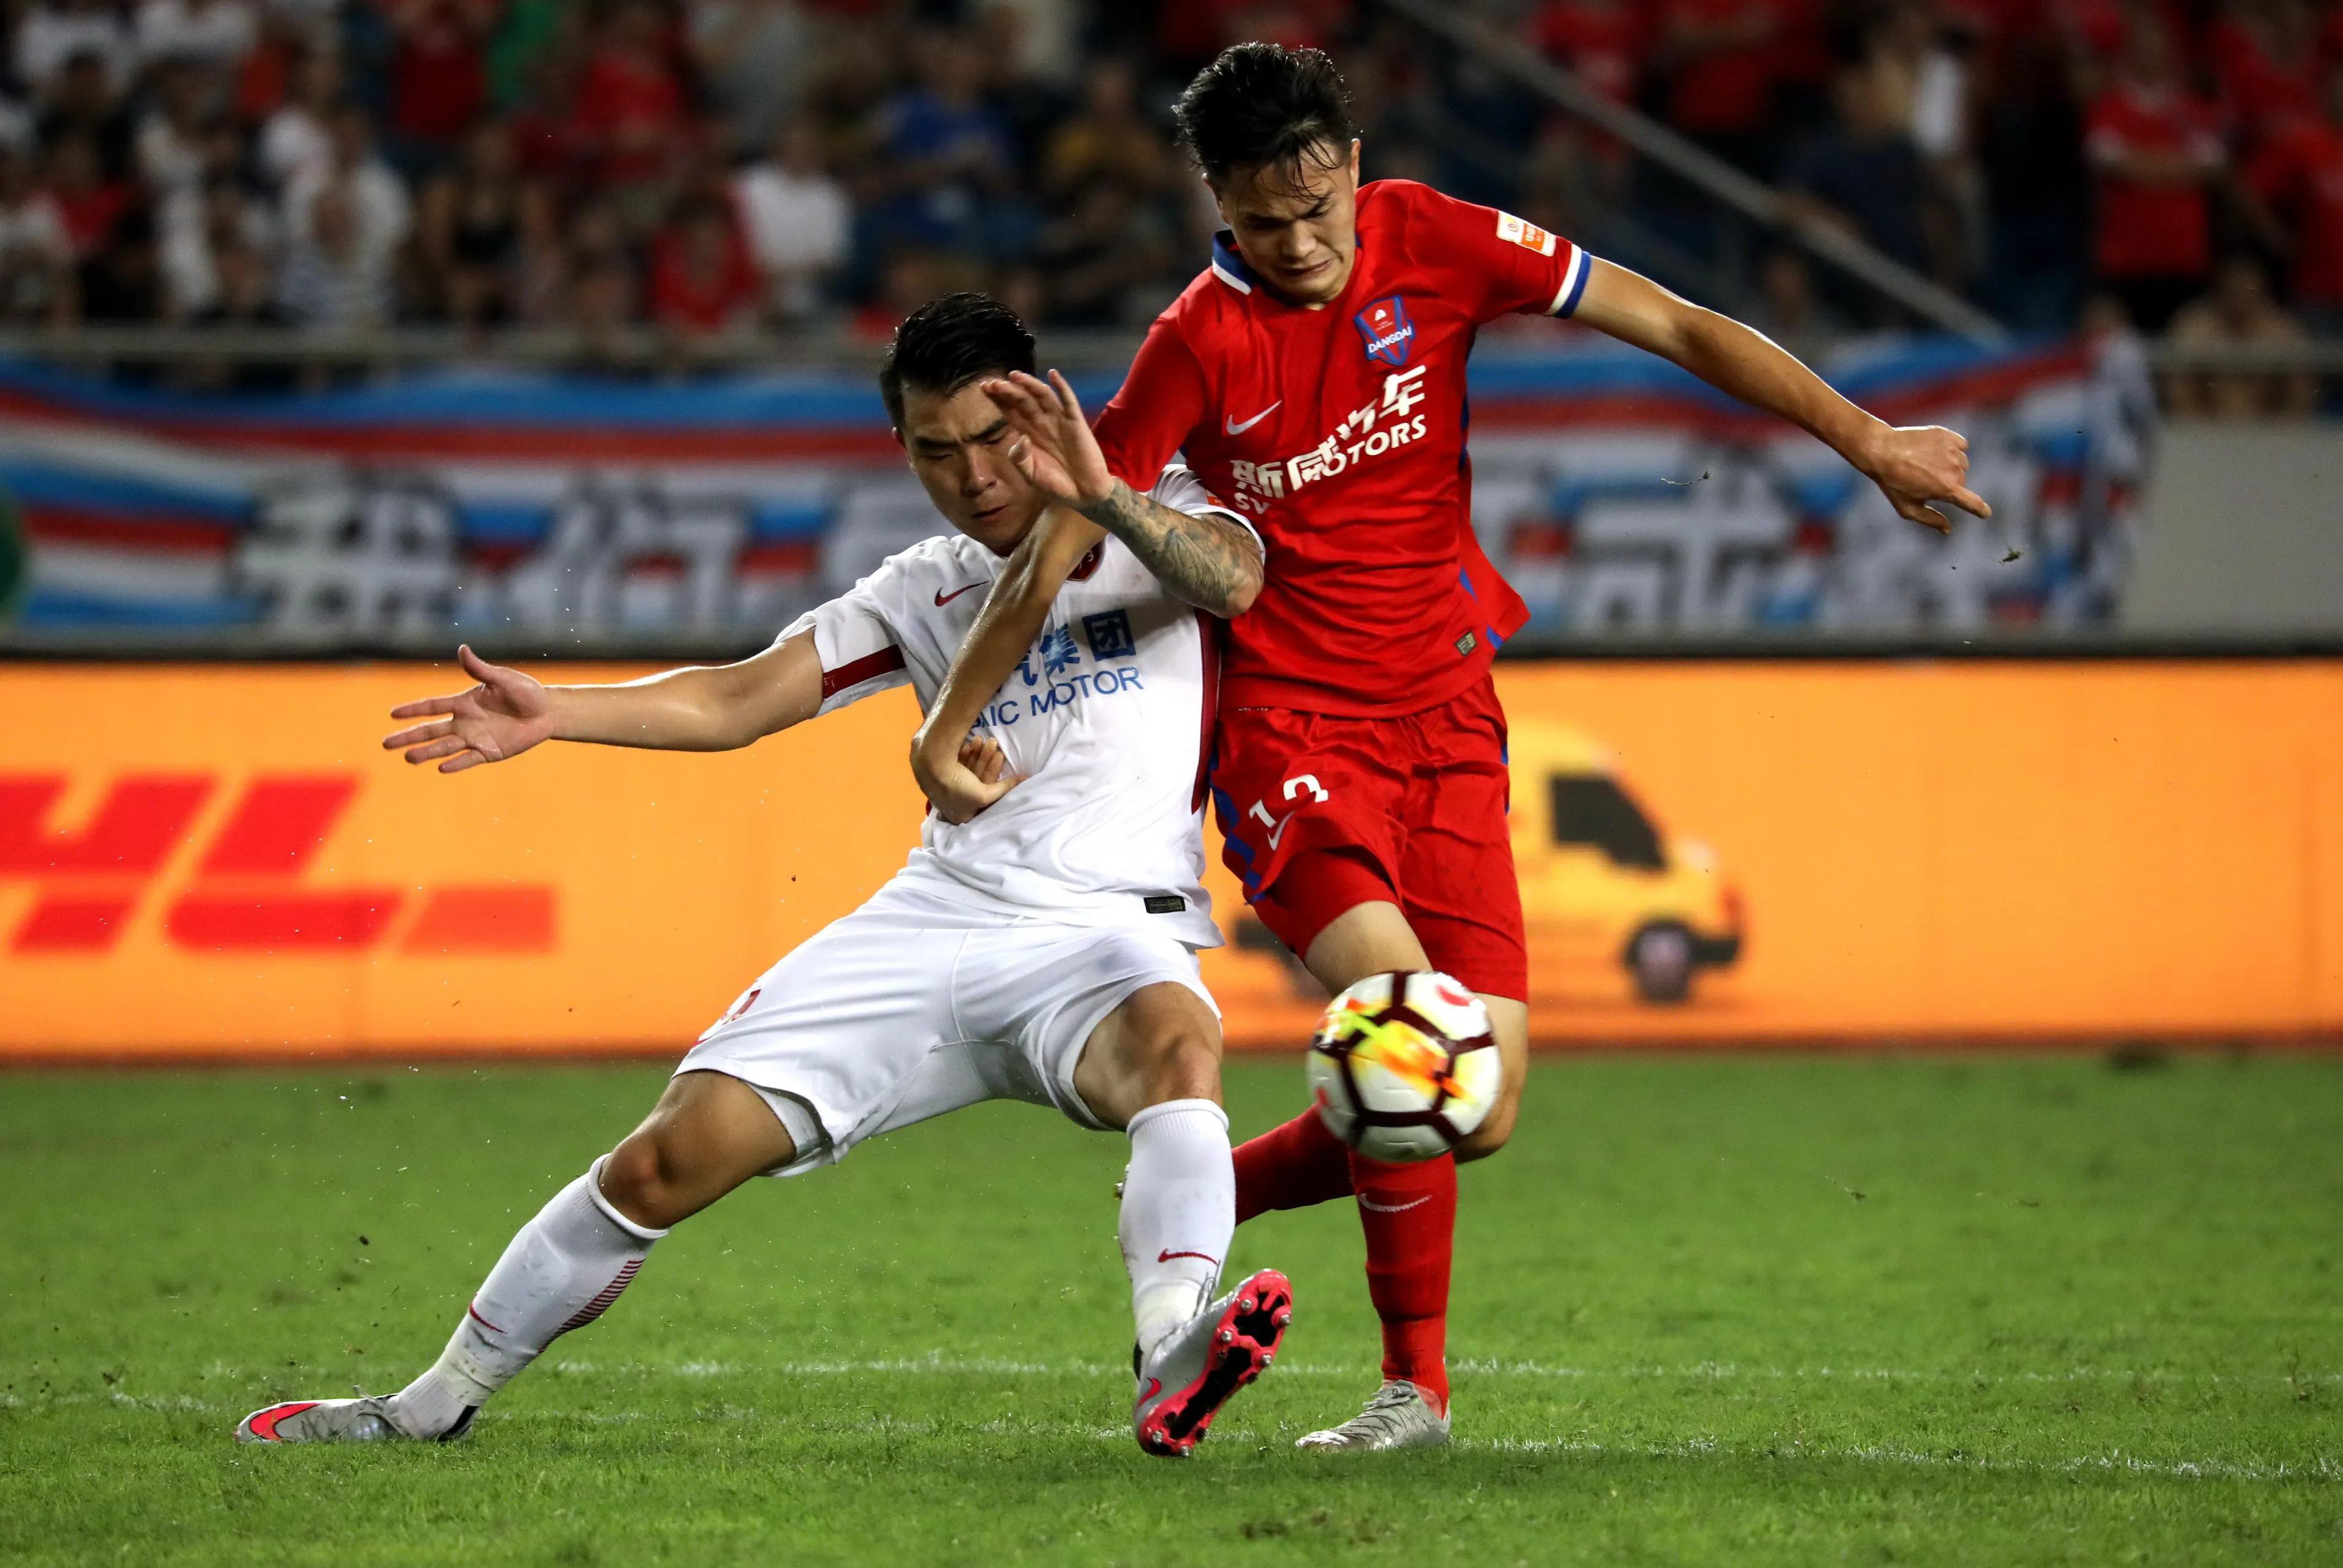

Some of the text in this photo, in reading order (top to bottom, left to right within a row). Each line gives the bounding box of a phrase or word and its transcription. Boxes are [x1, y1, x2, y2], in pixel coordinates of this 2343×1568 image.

[1368, 325, 1412, 353] DANGDAI
[1321, 414, 1427, 477] OTORS
[971, 666, 1144, 728] AIC MOTOR
[0, 774, 403, 953] HL
